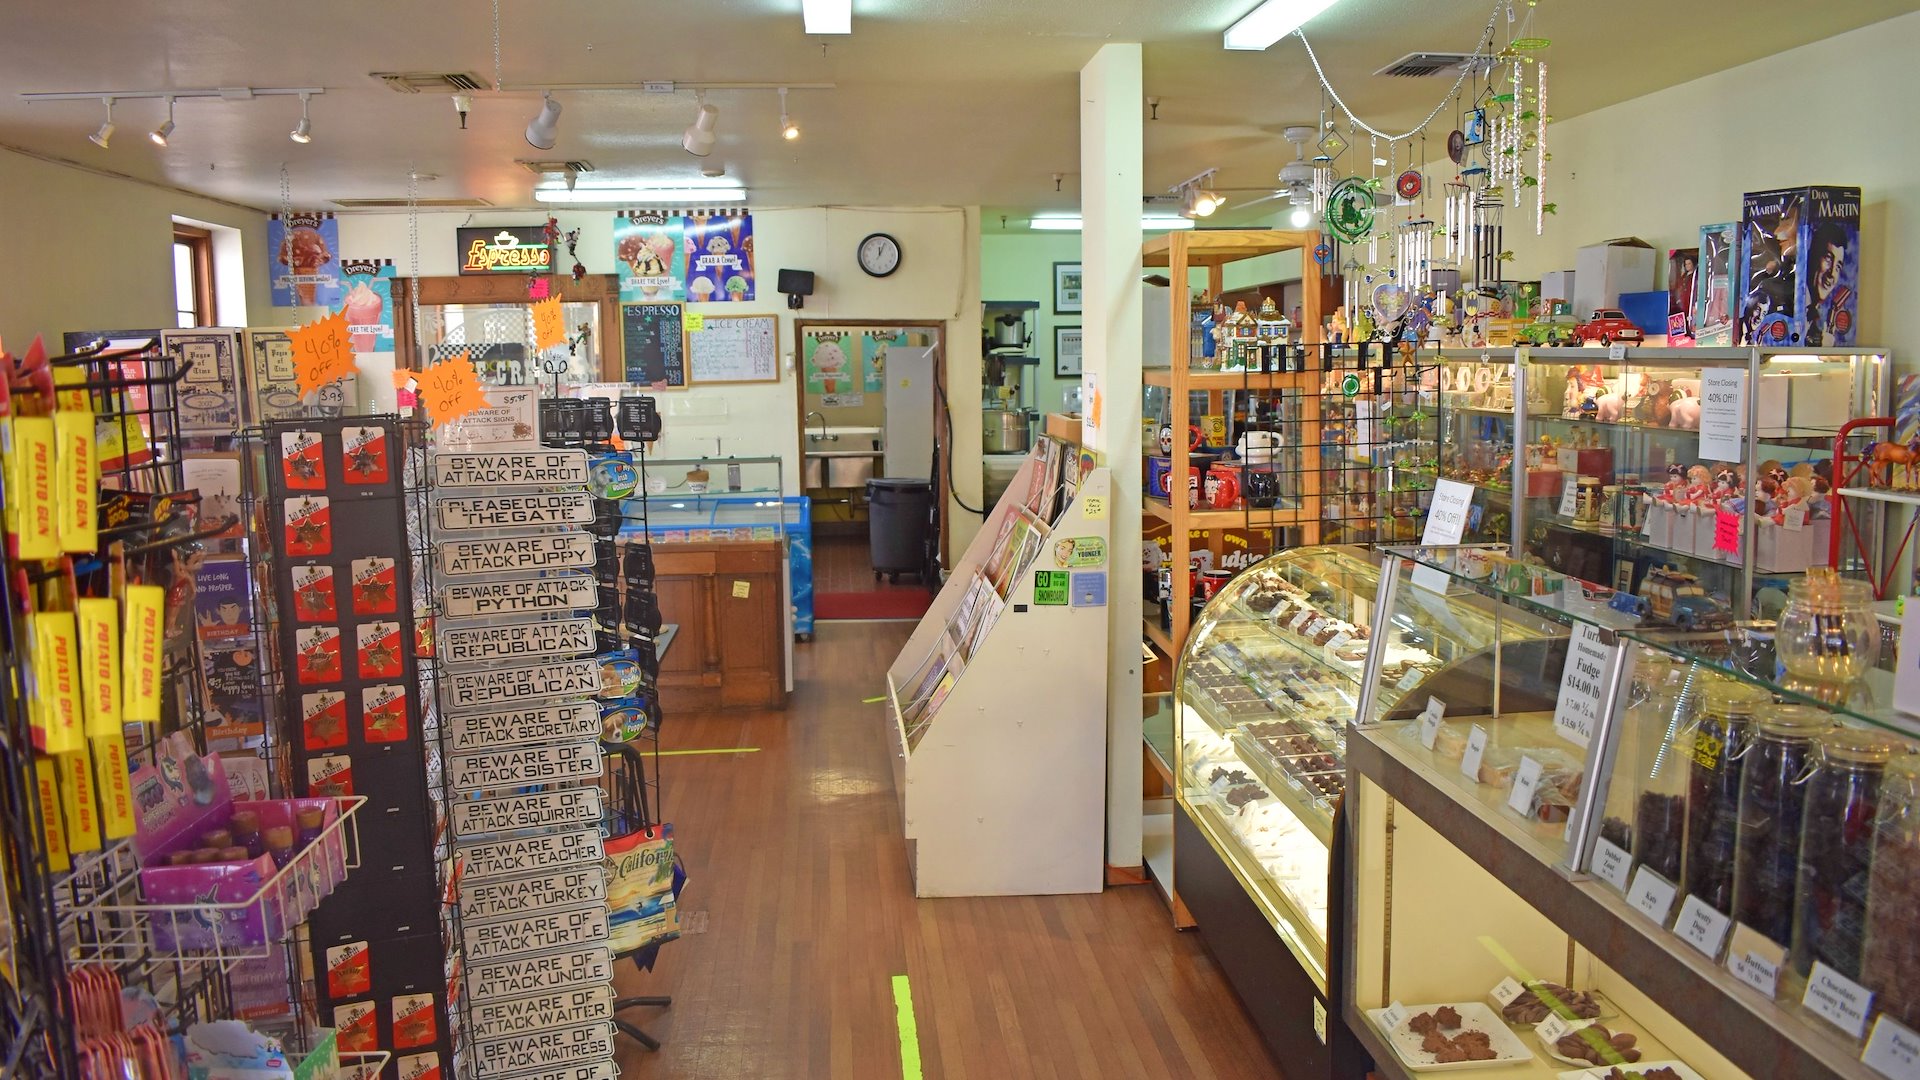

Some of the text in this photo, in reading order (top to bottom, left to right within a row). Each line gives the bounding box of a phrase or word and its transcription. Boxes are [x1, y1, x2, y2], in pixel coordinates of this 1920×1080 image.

[632, 214, 665, 226] Dreyer's
[463, 240, 550, 270] Espresso
[701, 256, 716, 264] GRAB
[346, 265, 377, 275] Dreyer's
[627, 305, 679, 316] ESPRESSO
[713, 318, 769, 329] ICE CREAM
[304, 329, 341, 360] 40%
[433, 369, 463, 393] 40%
[1707, 379, 1738, 388] Store Closing
[439, 393, 461, 412] OFF
[1707, 393, 1721, 403] 40%
[462, 416, 492, 424] ATTACK
[294, 436, 314, 451] Sheriff
[451, 456, 570, 470] BEWARE OF
[75, 435, 89, 529] POTATO GUN
[444, 468, 581, 482] ATTACK PARROT
[36, 442, 49, 536] POTATO GUN
[299, 502, 320, 517] Sheriff
[450, 495, 585, 513] PLEASE CLOSE
[462, 508, 575, 525] THE GATE
[1435, 510, 1447, 522] 40%
[458, 537, 577, 557] BEWARE OF
[451, 550, 587, 571] ATTACK PUPPY
[197, 572, 229, 582] LIVE LONG
[305, 569, 326, 583] Sheriff
[1037, 572, 1049, 587] GO
[453, 580, 589, 599] BEWARE OF ATTACK
[1038, 590, 1064, 602] SNOWBOARD
[476, 594, 568, 611] PYTHON
[206, 629, 239, 637] BIRTHDAY
[311, 631, 331, 646] Sheriff
[450, 623, 587, 645] BEWARE OF ATTACK
[141, 607, 156, 698] POTATO GUN
[453, 636, 589, 659] REPUBLICAN
[1577, 642, 1607, 662] Homemade
[97, 622, 111, 714] POTATO GUN
[457, 663, 593, 689] BEWARE OF ATTACK
[1576, 657, 1600, 680] Fudge
[376, 691, 397, 704] Sheriff
[459, 677, 595, 702] REPUBLICAN
[1567, 674, 1600, 699] $14.00 lb
[466, 708, 583, 730] BEWARE OF
[212, 727, 247, 736] Birthday
[459, 719, 597, 745] ATTACK SECRETARY
[467, 747, 583, 768] BEWARE OF
[460, 759, 593, 785] ATTACK SISTER
[469, 793, 584, 816] BEWARE OF
[462, 806, 596, 831] ATTACK SQUIRREL
[471, 835, 585, 860] BEWARE OF
[465, 846, 597, 873] ATTACK TEACHER
[474, 874, 588, 900] BEWARE OF
[467, 885, 598, 915] ATTACK TURKEY
[478, 912, 592, 940] BEWARE OF
[472, 924, 604, 956] ATTACK TURTLE
[482, 953, 595, 979] BEWARE OF
[1744, 954, 1774, 979] Buttons
[477, 965, 604, 996] ATTACK UNCLE
[1821, 976, 1857, 1002] Chocolate
[483, 991, 595, 1019] BEWARE OF
[1809, 984, 1860, 1020] Gummy Bears
[476, 1003, 606, 1036] ATTACK WAITER
[484, 1028, 596, 1057] BEWARE OF
[478, 1041, 607, 1074] ATTACK WAITRESS
